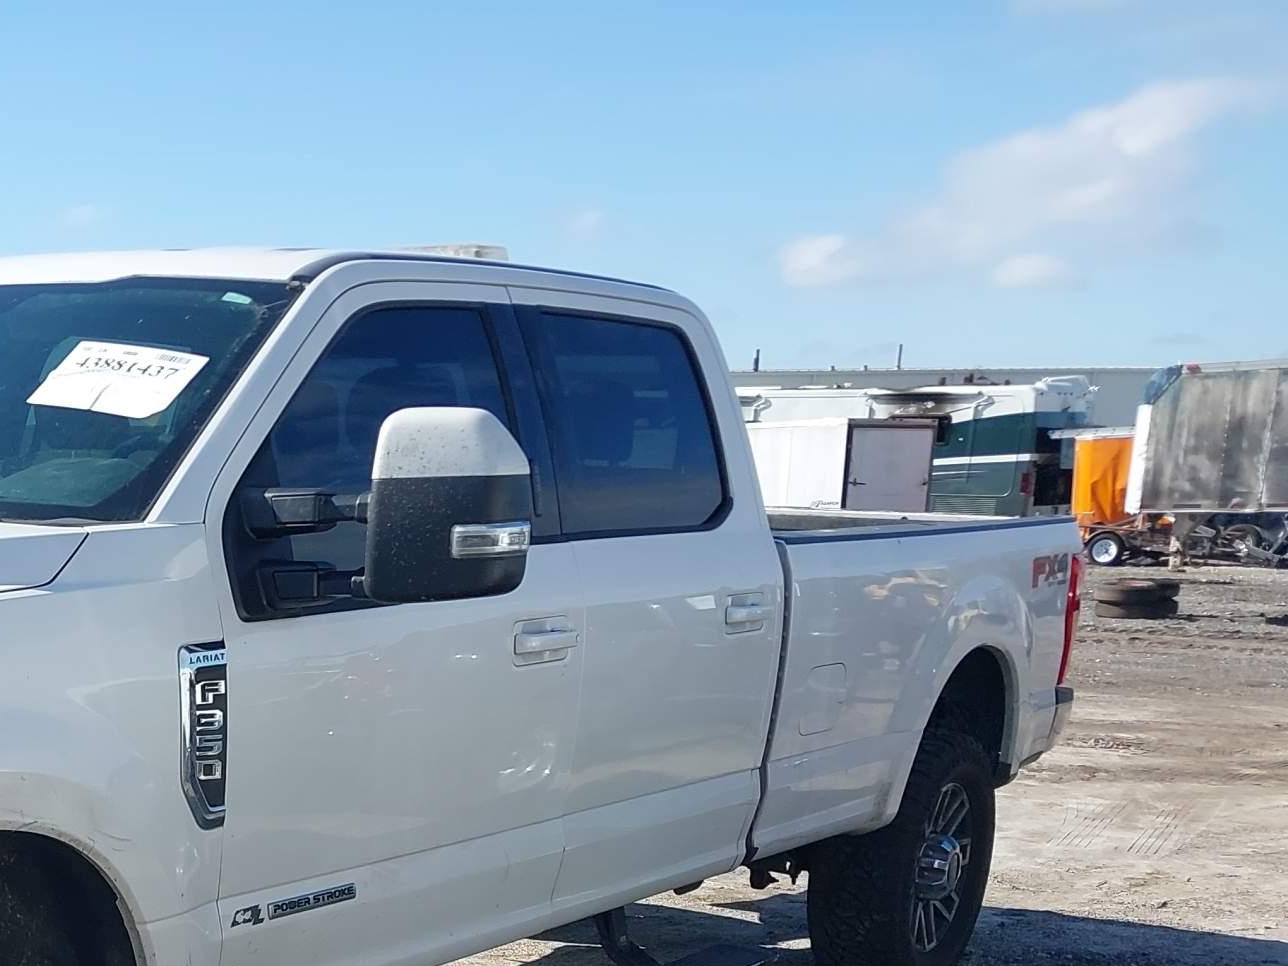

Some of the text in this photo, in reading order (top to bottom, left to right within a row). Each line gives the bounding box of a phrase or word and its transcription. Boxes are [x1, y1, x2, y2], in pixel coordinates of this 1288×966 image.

[76, 357, 179, 379] 43881437
[189, 652, 226, 665] LARIAT
[272, 885, 354, 914] POWER STROKE
